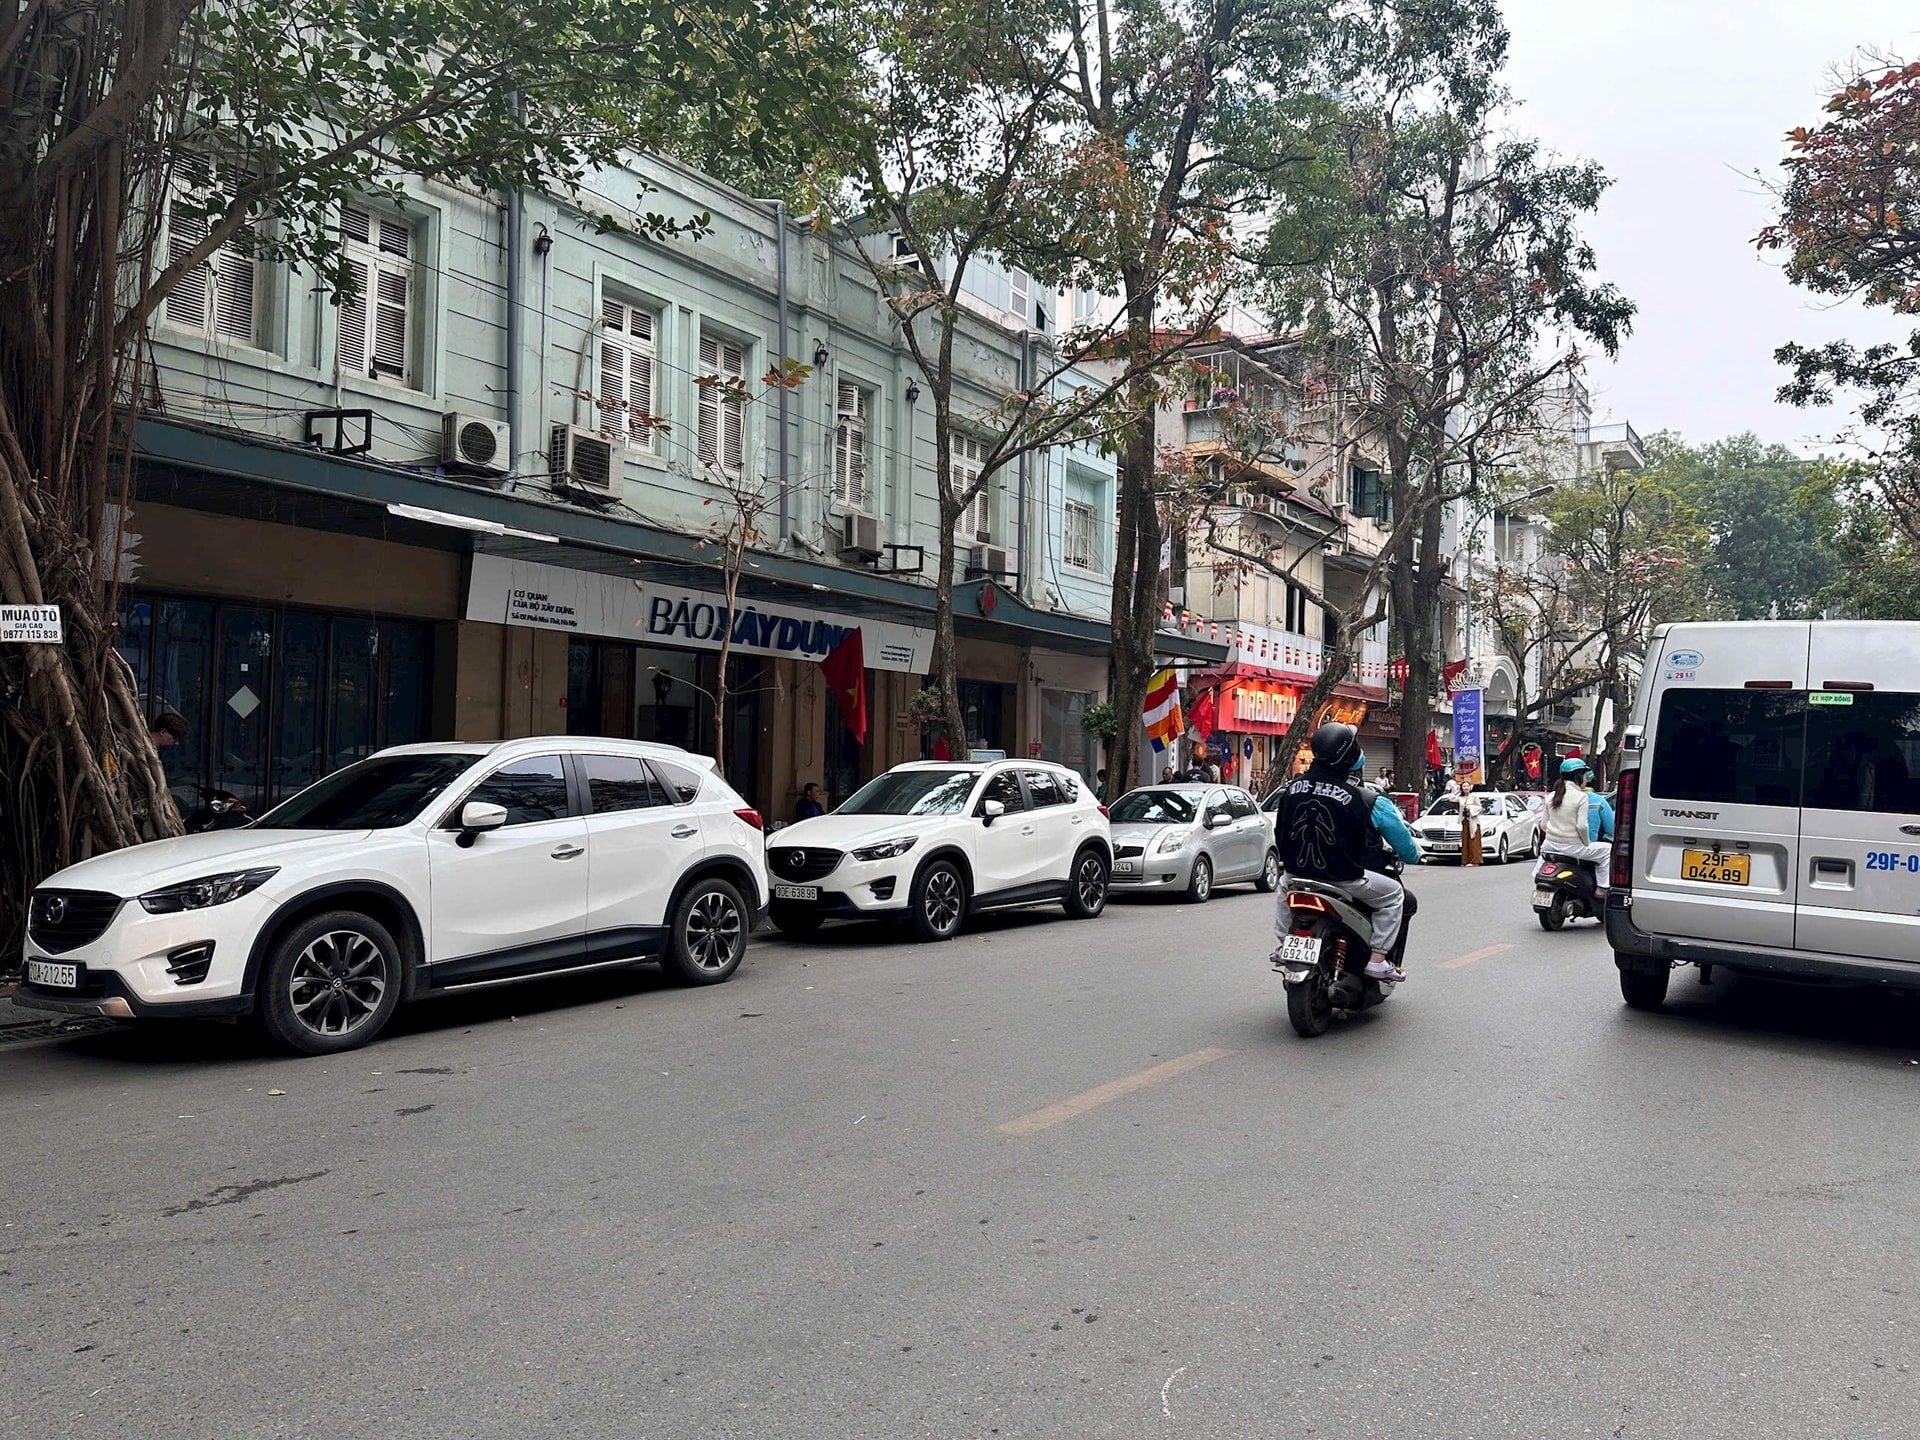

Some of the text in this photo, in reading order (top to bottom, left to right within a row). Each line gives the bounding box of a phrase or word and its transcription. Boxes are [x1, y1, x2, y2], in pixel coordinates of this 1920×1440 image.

[527, 592, 548, 601] QUAN
[649, 597, 714, 639] BÁO
[3, 630, 58, 639] 0877 115 838
[1459, 746, 1477, 754] 2026
[1661, 808, 1720, 820] TRANSIT
[1701, 853, 1730, 866] 29F
[1866, 852, 1920, 873] 29F-0
[1689, 865, 1741, 882] 044.89
[1283, 948, 1316, 962] 692.40
